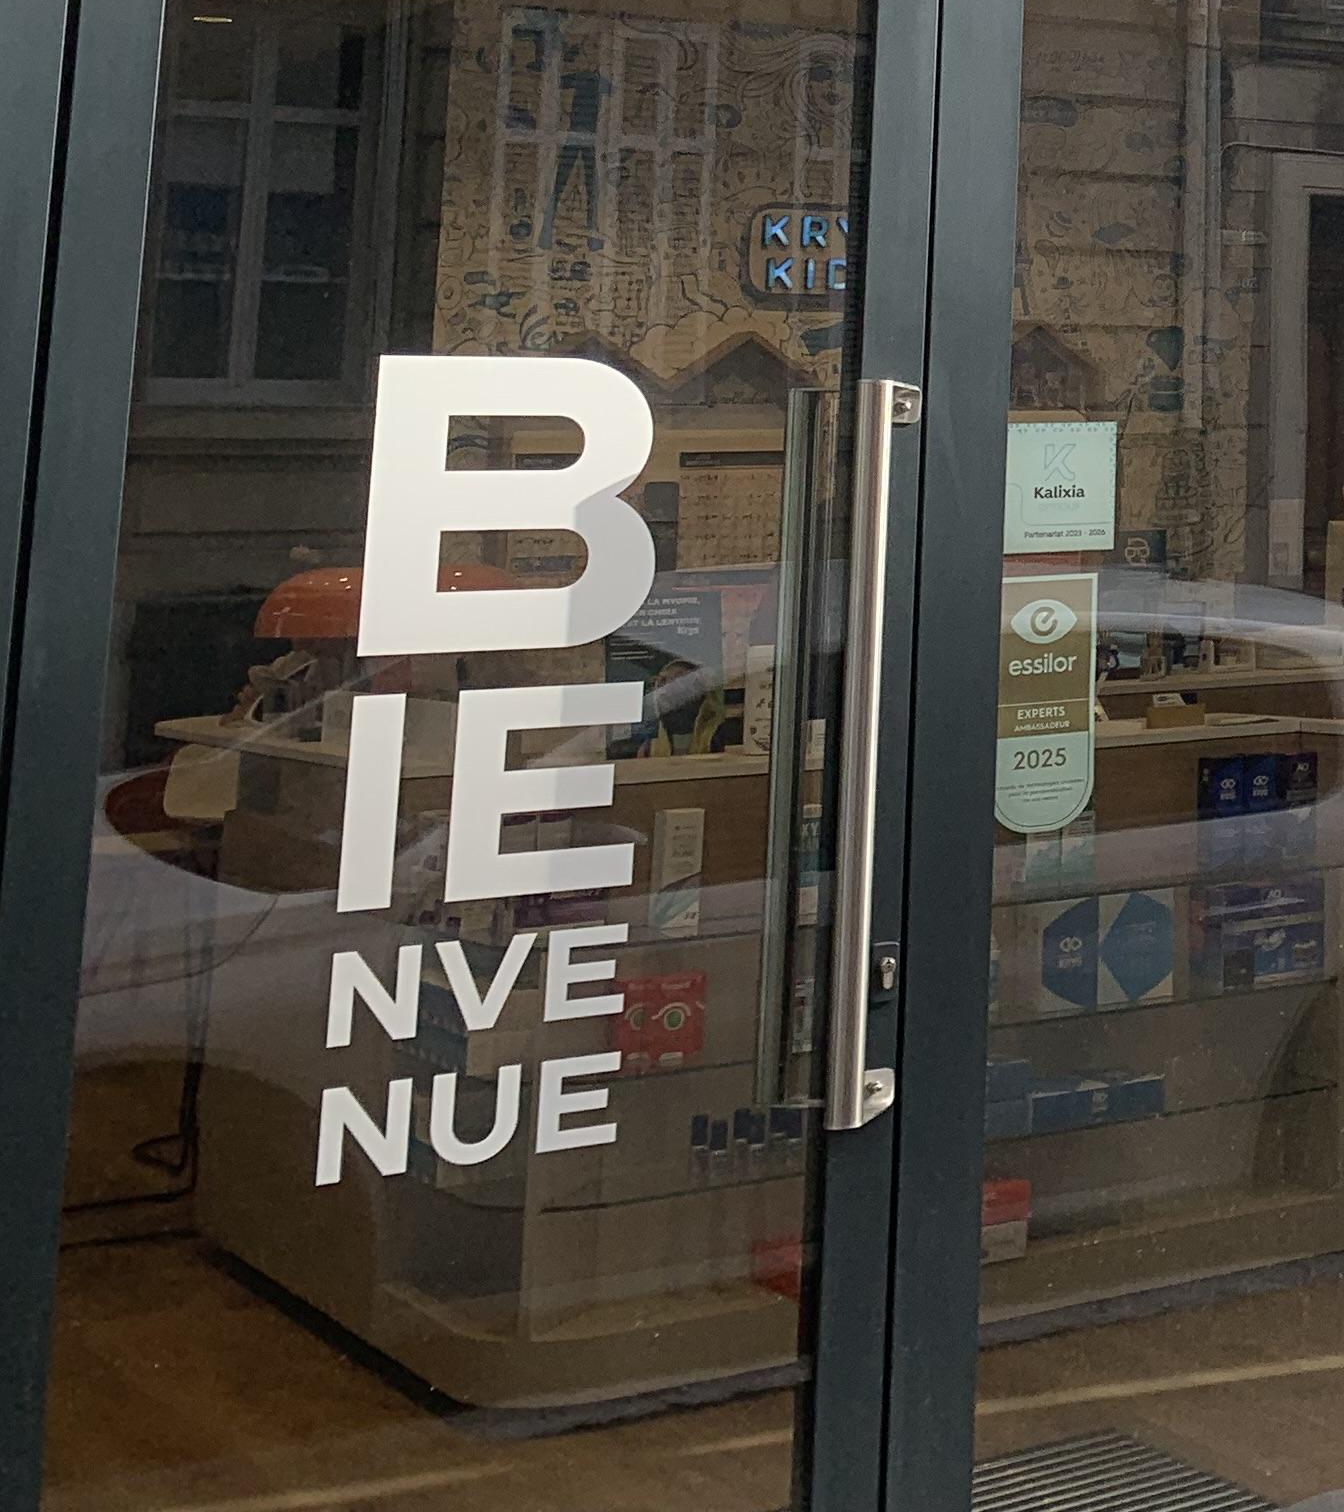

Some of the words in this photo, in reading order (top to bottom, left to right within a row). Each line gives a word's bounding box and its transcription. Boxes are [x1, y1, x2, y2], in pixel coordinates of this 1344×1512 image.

[1034, 484, 1085, 499] Kalixia
[356, 354, 656, 657] B
[1024, 530, 1064, 539] Partenariat
[1008, 653, 1077, 676] essilor
[1017, 706, 1066, 720] EXPERTS
[1014, 720, 1070, 732] AMBASSADEUR
[1013, 748, 1067, 770] 2025
[336, 680, 645, 913] IE
[326, 922, 629, 1048] NVE
[315, 1049, 622, 1187] NUE
